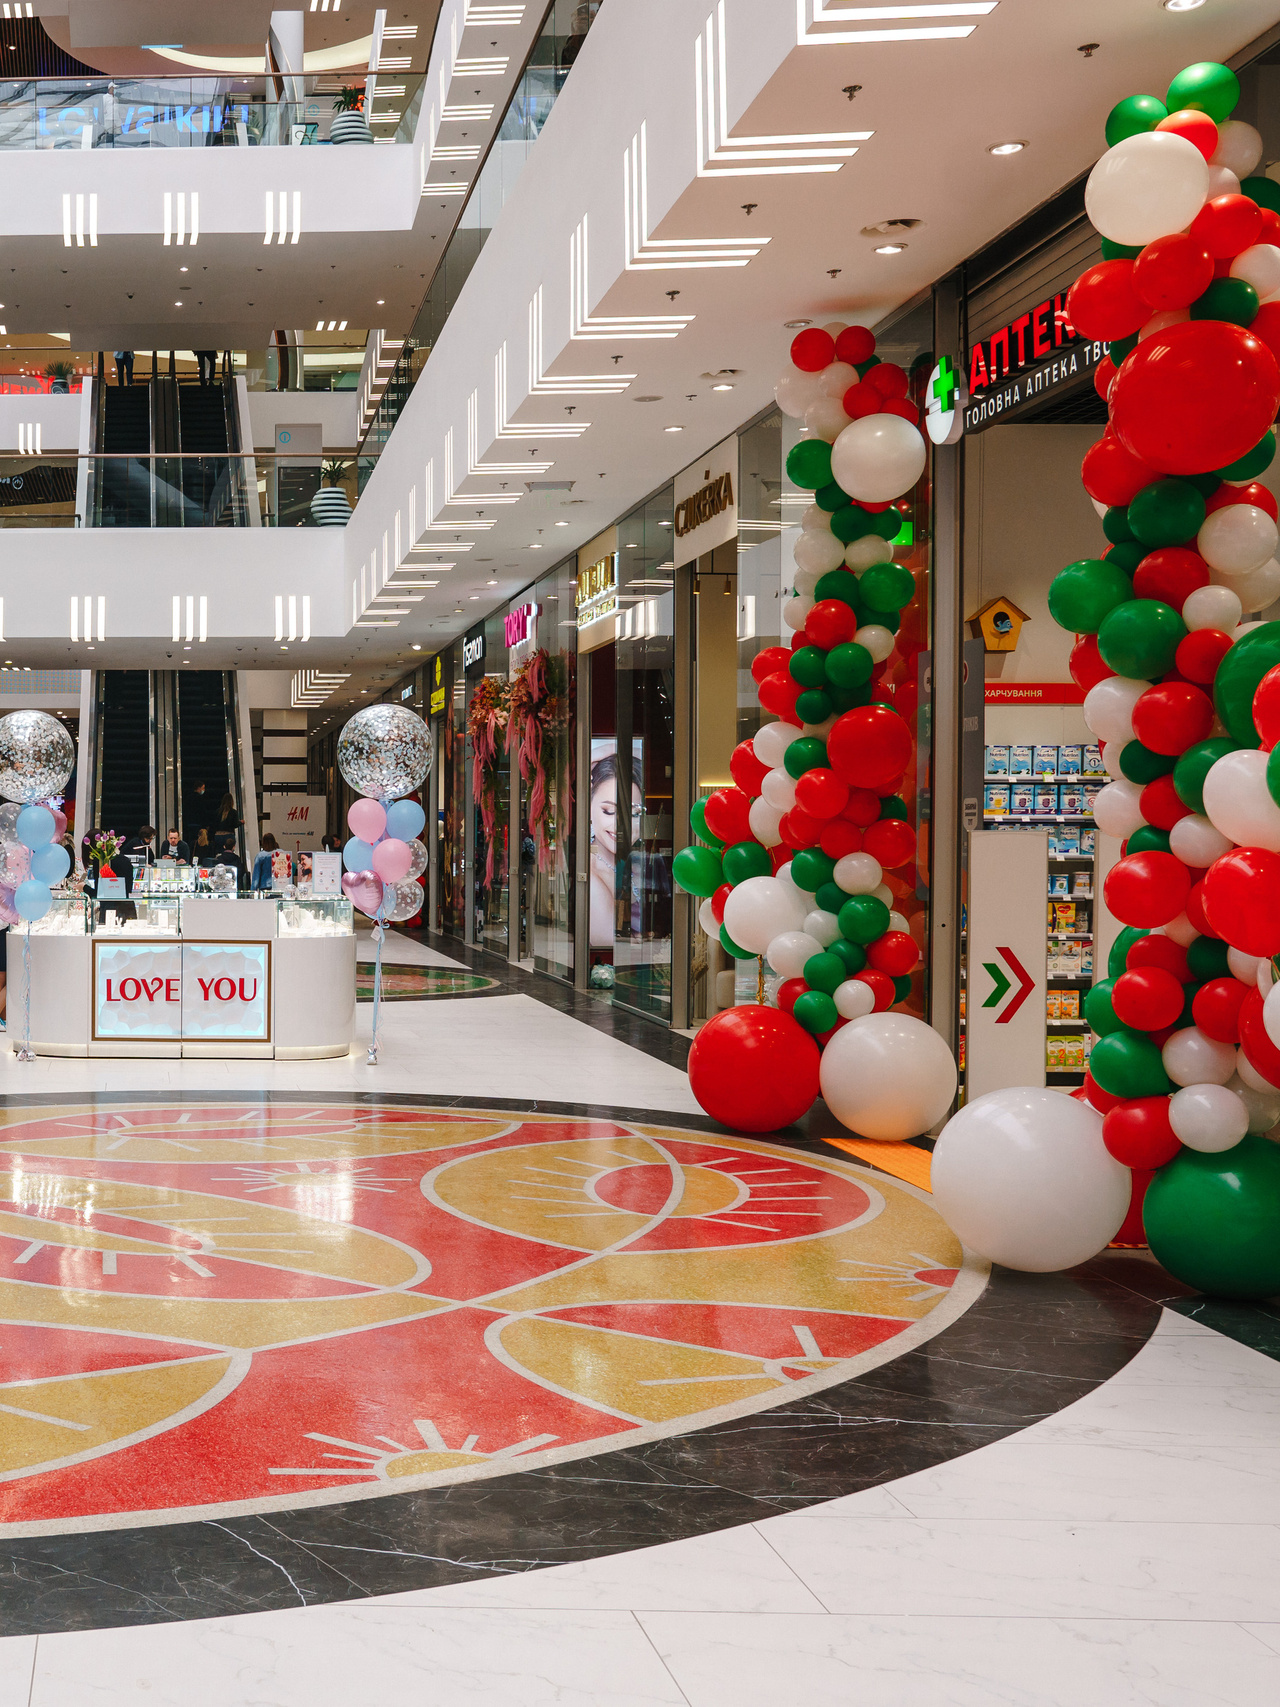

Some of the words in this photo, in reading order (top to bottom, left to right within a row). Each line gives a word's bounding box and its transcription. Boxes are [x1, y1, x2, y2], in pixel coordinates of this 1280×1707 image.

[966, 384, 1020, 429] ГОЛОВНА
[1026, 353, 1078, 397] АПТЕКА
[984, 689, 1043, 698] ХАРЧУВАННЯ
[287, 806, 310, 821] H&M
[106, 977, 180, 1002] LOVE
[197, 977, 257, 1002] YOU
